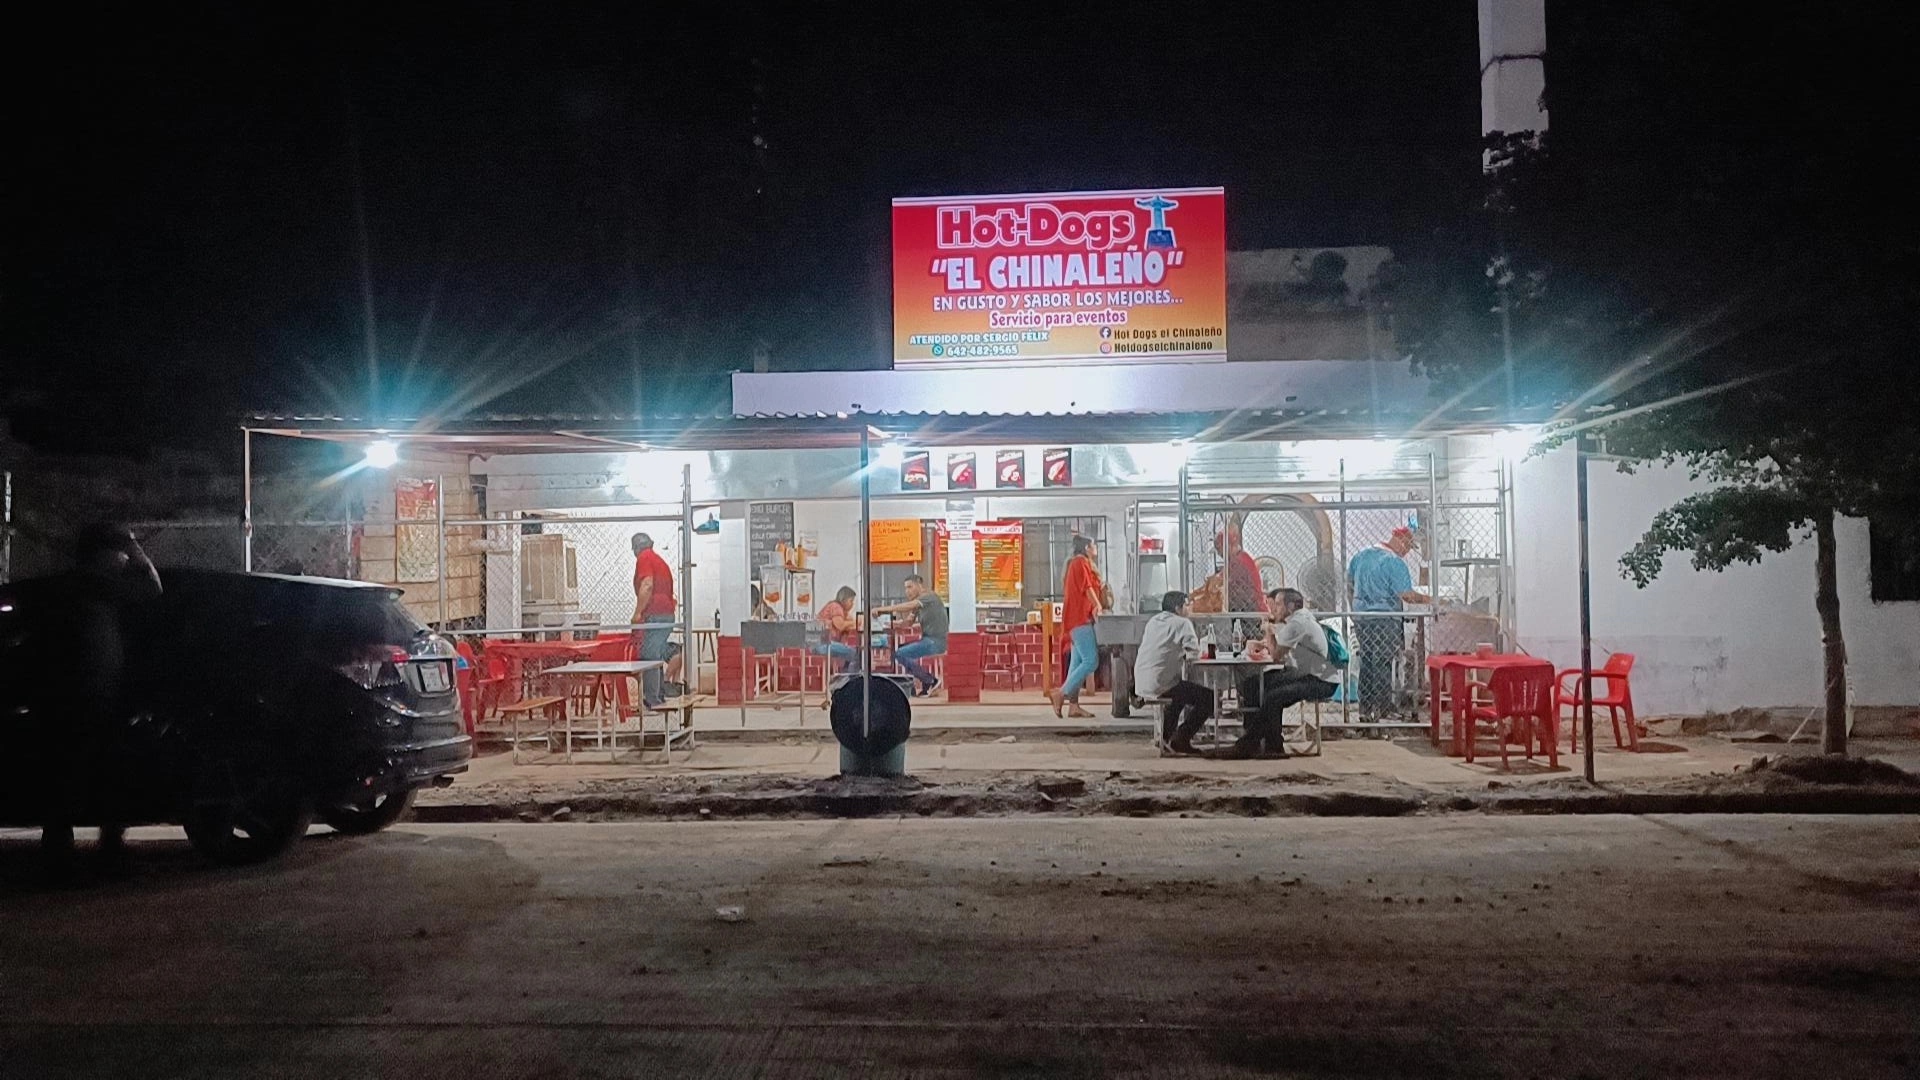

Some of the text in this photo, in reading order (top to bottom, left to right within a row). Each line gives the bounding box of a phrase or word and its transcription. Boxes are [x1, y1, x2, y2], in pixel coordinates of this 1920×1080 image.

[937, 203, 1135, 250] Hot-Dogs
[933, 296, 953, 311] EN
[957, 295, 1007, 310] GUSTO
[1023, 293, 1072, 308] SABOR
[1076, 292, 1102, 306] LOS
[1107, 290, 1183, 307] MEJORES...
[991, 310, 1126, 328] Servicio para eventos
[910, 335, 959, 345] ATENDIDO
[961, 334, 980, 344] POR
[982, 333, 1019, 343] SERGIO
[1114, 326, 1222, 340] Hot Dogs el Chinaleño
